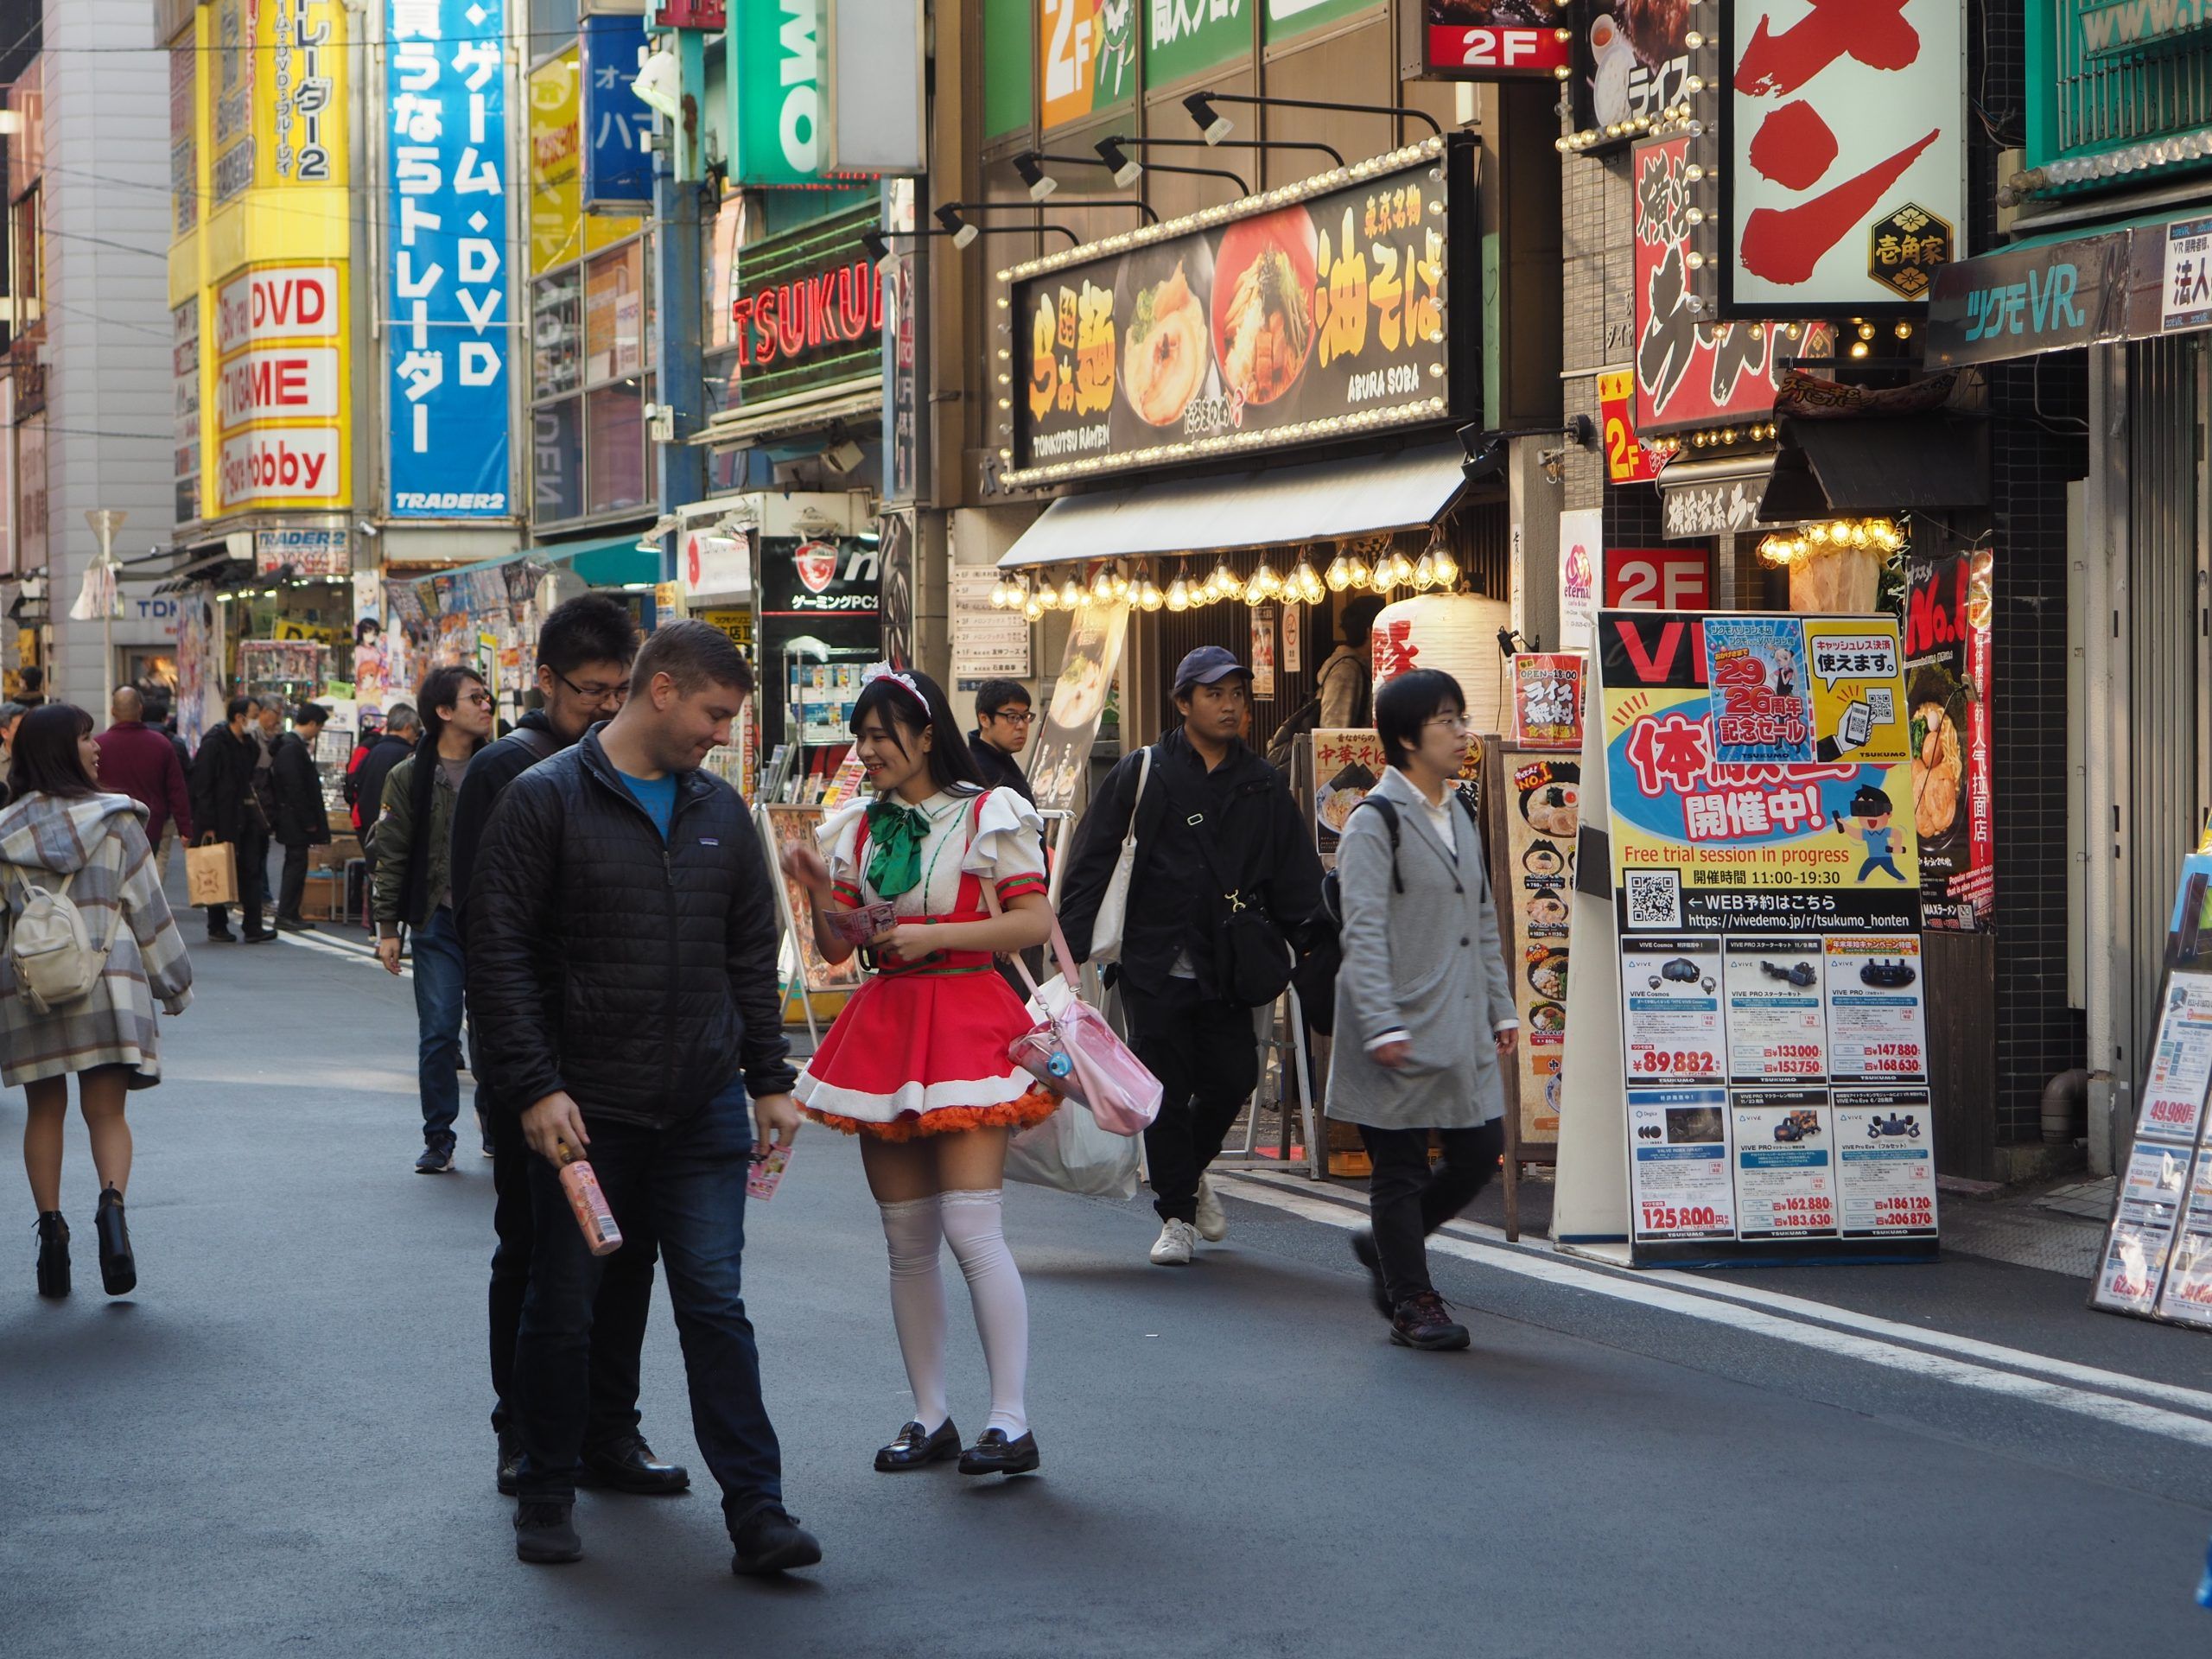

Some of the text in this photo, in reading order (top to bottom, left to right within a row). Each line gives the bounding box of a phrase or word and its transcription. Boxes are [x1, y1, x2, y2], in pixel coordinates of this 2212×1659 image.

[1463, 29, 1537, 66] 2F
[296, 0, 332, 180] レーダー2
[1629, 54, 1690, 118] ライス
[1364, 183, 1421, 238] 東京名物
[1875, 234, 1946, 265] 壱角家
[1315, 207, 1442, 368] 油そば
[253, 278, 326, 329] DVD
[1347, 362, 1420, 404] ABURA SOBA
[1033, 423, 1110, 458] TONKOTSU RAMEN
[1605, 417, 1639, 479] 2F
[396, 492, 505, 509] TRADER2
[1563, 584, 1592, 600] eternal
[1617, 560, 1705, 608] 2F
[1817, 640, 1891, 651] キャッシュレス決済
[1714, 656, 1766, 688] 29
[1817, 653, 1895, 672] 使えます。
[1522, 679, 1573, 702] ライス
[1725, 685, 1803, 717] 26周年
[1524, 700, 1574, 725] 無料
[1719, 716, 1808, 746] 記念セール
[1685, 785, 1823, 839] 開催中!
[1624, 845, 1850, 866] Free trial session in progress
[1694, 870, 1840, 885] 開催時間 11:00-19:30
[1705, 894, 1836, 912] WEB予約はこちら
[1688, 912, 1910, 929] https://vivedemo.jp/r/tsukumo_honten
[1632, 1051, 1714, 1074] ¥89,882
